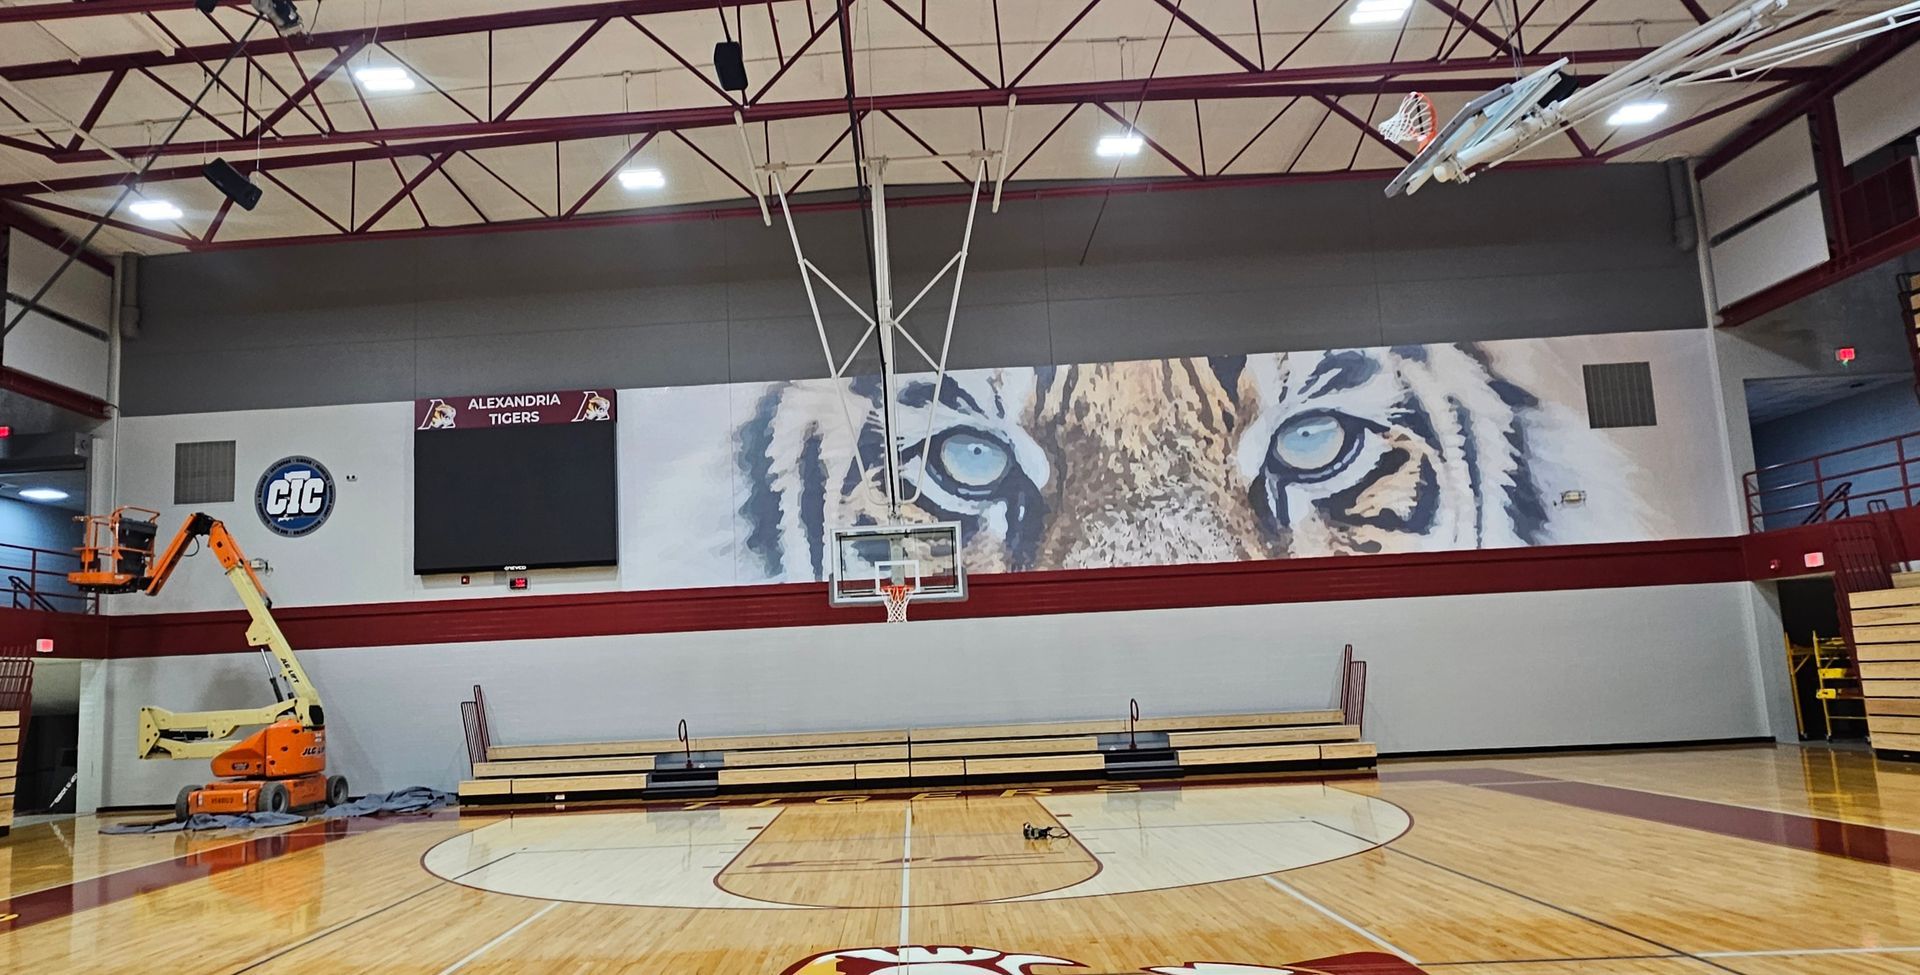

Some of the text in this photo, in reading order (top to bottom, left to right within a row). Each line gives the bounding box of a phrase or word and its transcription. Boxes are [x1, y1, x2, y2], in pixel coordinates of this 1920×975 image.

[467, 393, 561, 410] ALEXANDRIA
[488, 411, 540, 425] TIGERS
[266, 472, 325, 515] CIC
[281, 658, 300, 683] JLG LIFT
[683, 785, 1141, 810] TIGERS
